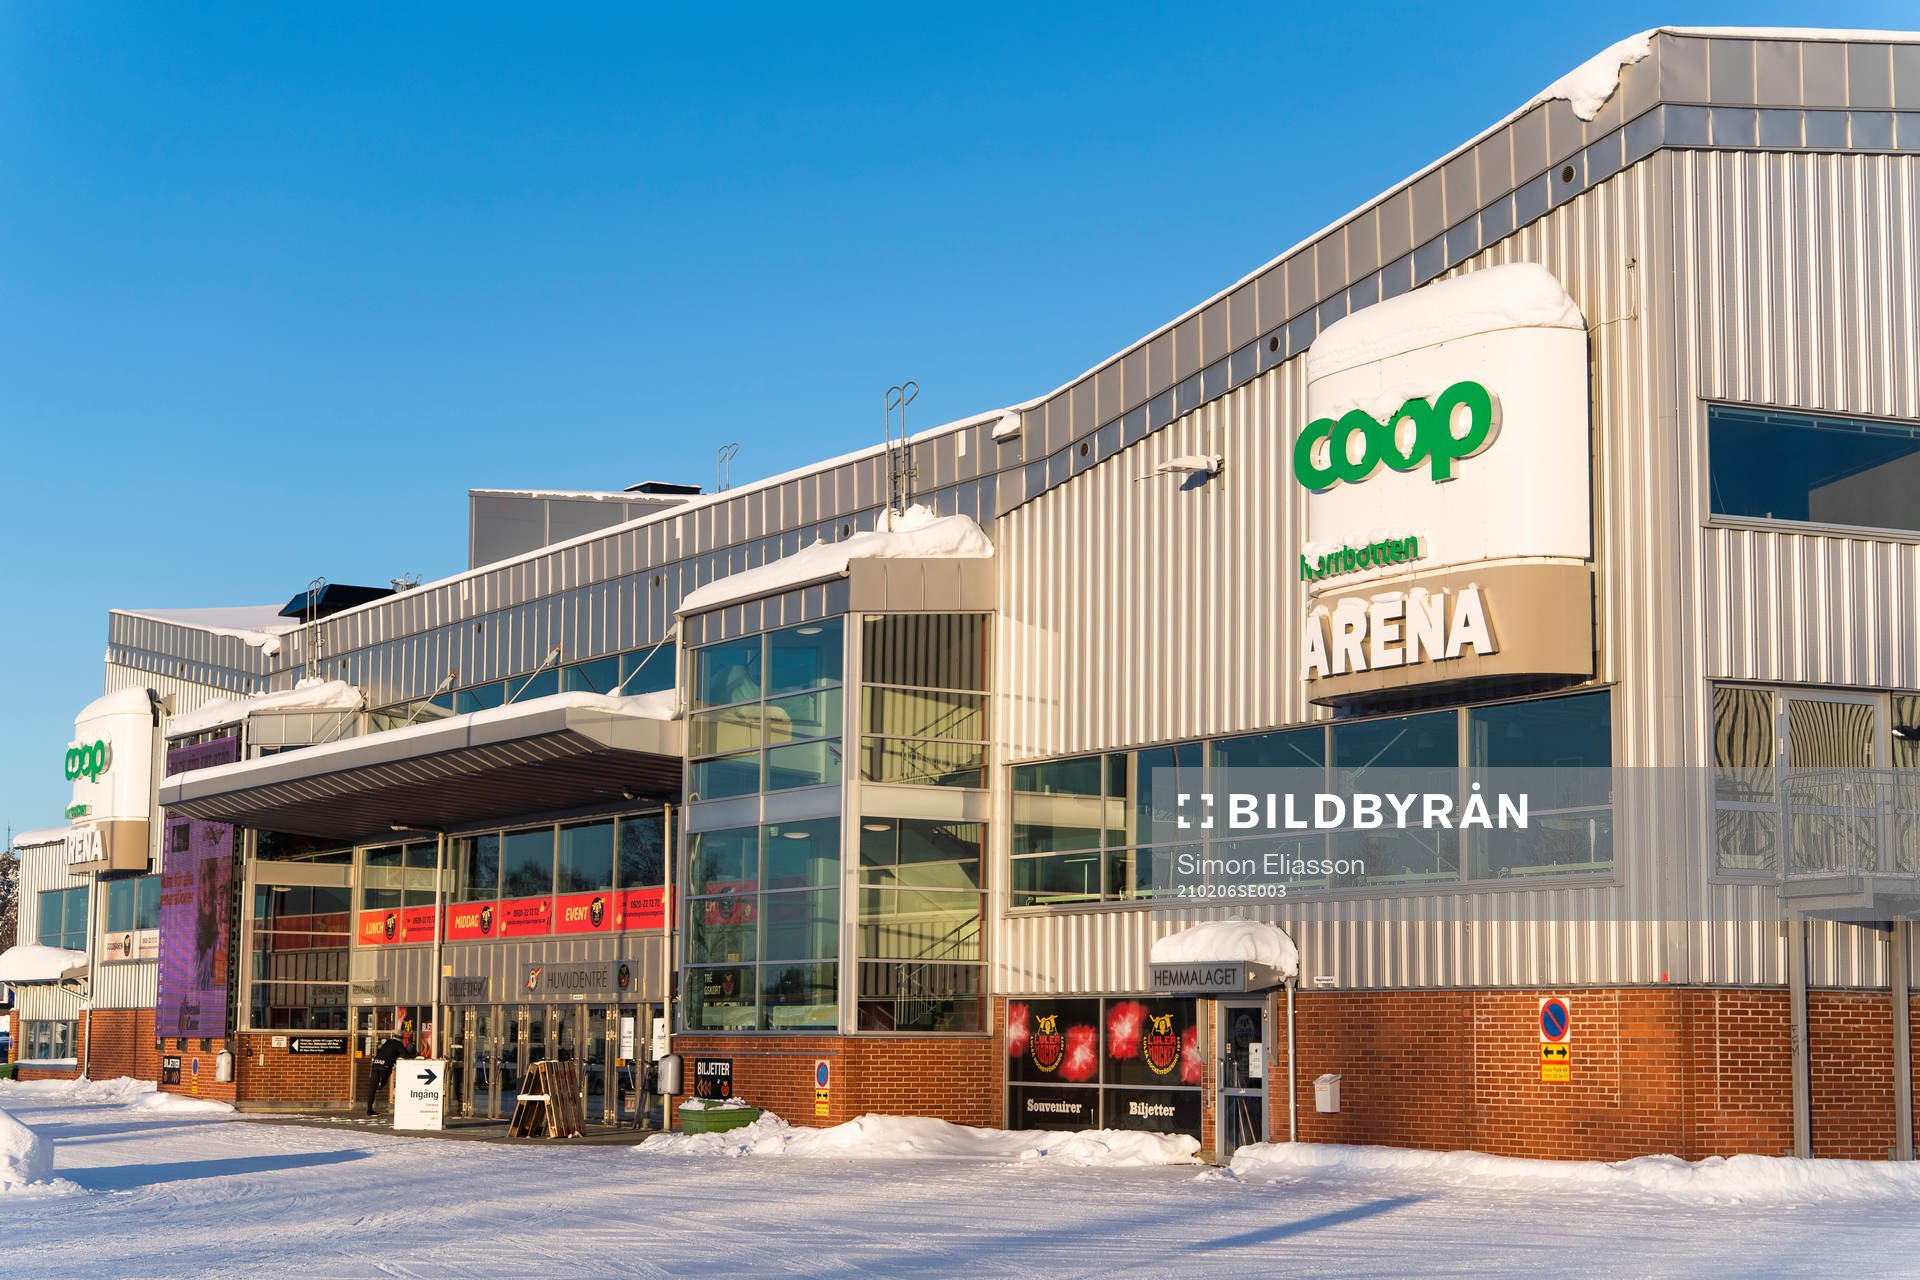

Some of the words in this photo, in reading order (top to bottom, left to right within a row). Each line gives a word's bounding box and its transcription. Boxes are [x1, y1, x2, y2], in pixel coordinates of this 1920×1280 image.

[1293, 380, 1496, 491] coop
[1300, 587, 1496, 681] ARENA
[65, 739, 106, 783] coop
[455, 914, 480, 929] MIDDAG
[565, 906, 588, 921] EVENT
[365, 921, 385, 934] LUNCH
[547, 967, 608, 989] HUVUDENTRÉ
[1154, 968, 1237, 986] HEMMALAGET
[697, 1062, 730, 1076] BILJETTER
[410, 1089, 439, 1100] Ingång
[1026, 1098, 1083, 1114] Souvenirer
[1129, 1101, 1176, 1119] Biljetter
